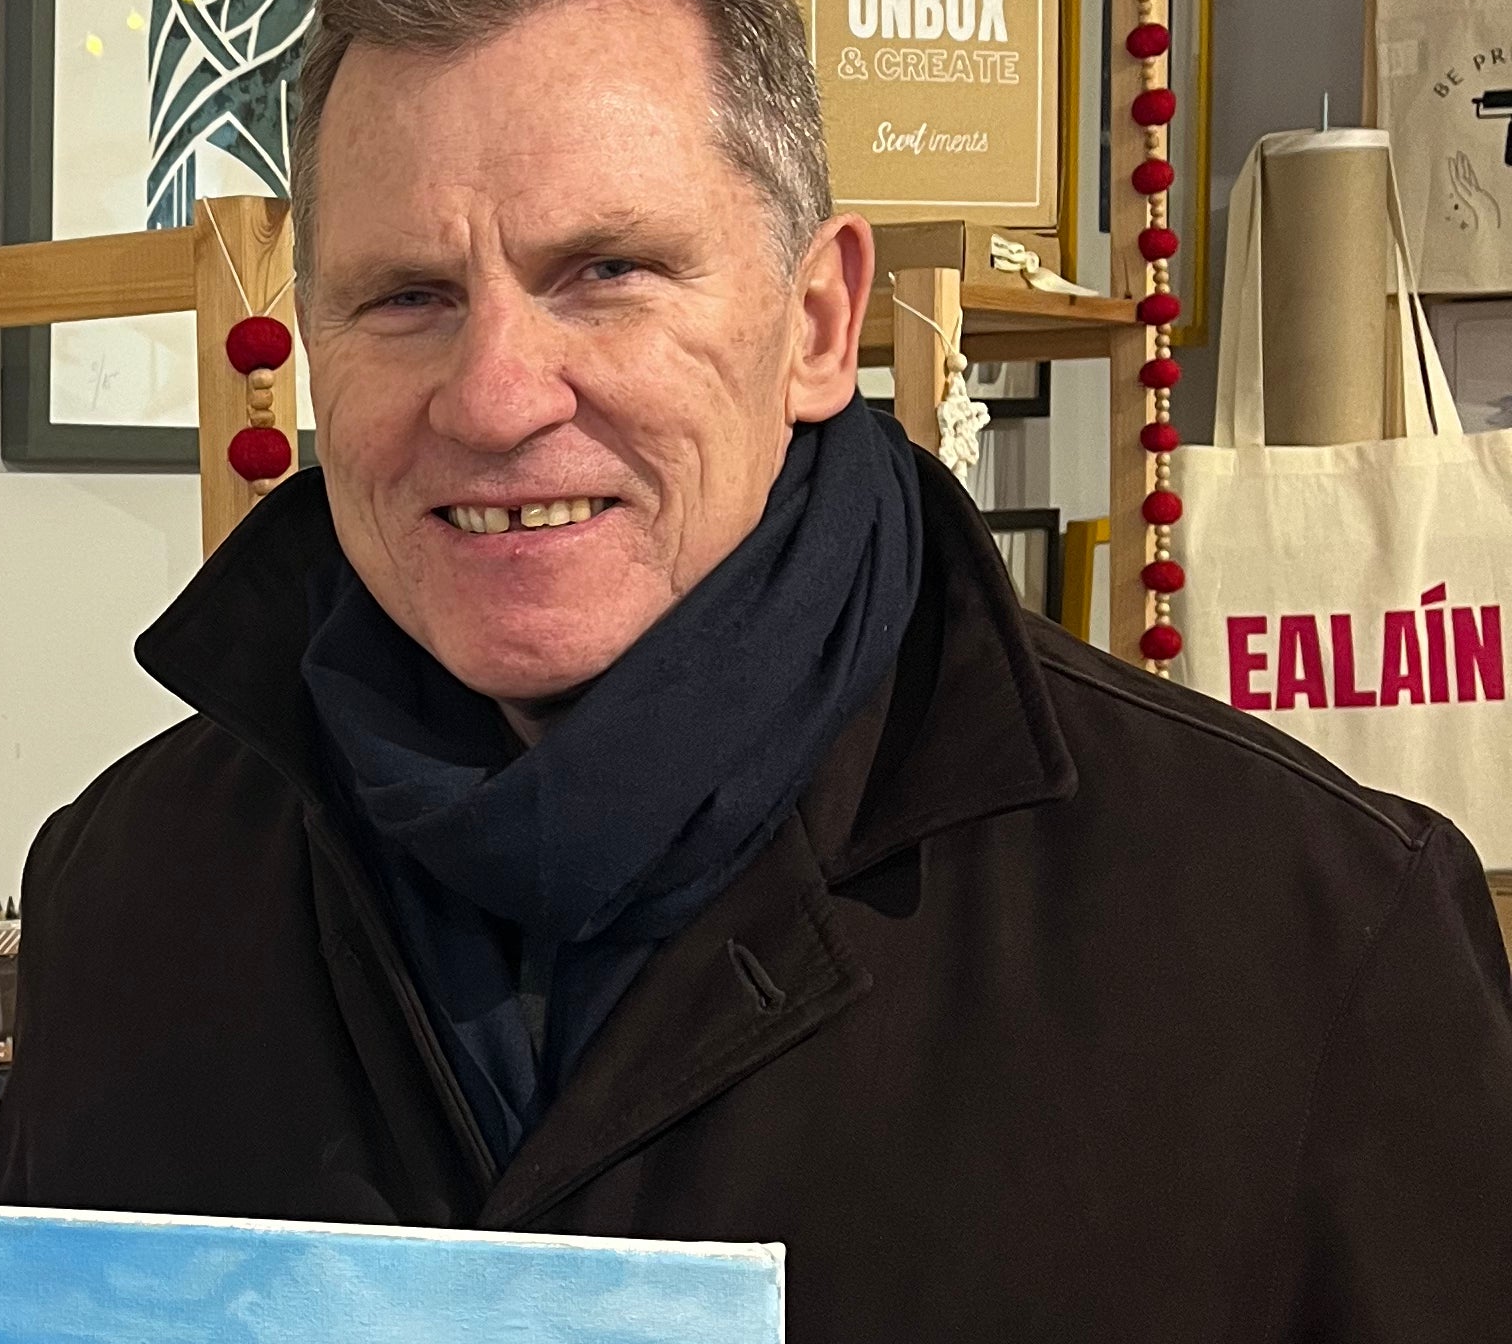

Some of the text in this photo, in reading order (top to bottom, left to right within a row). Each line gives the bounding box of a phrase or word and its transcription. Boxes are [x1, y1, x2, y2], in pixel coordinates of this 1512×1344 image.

[837, 46, 1020, 84] & CREATE
[1433, 47, 1512, 99] BE PR
[1226, 580, 1506, 711] EALAÍN
